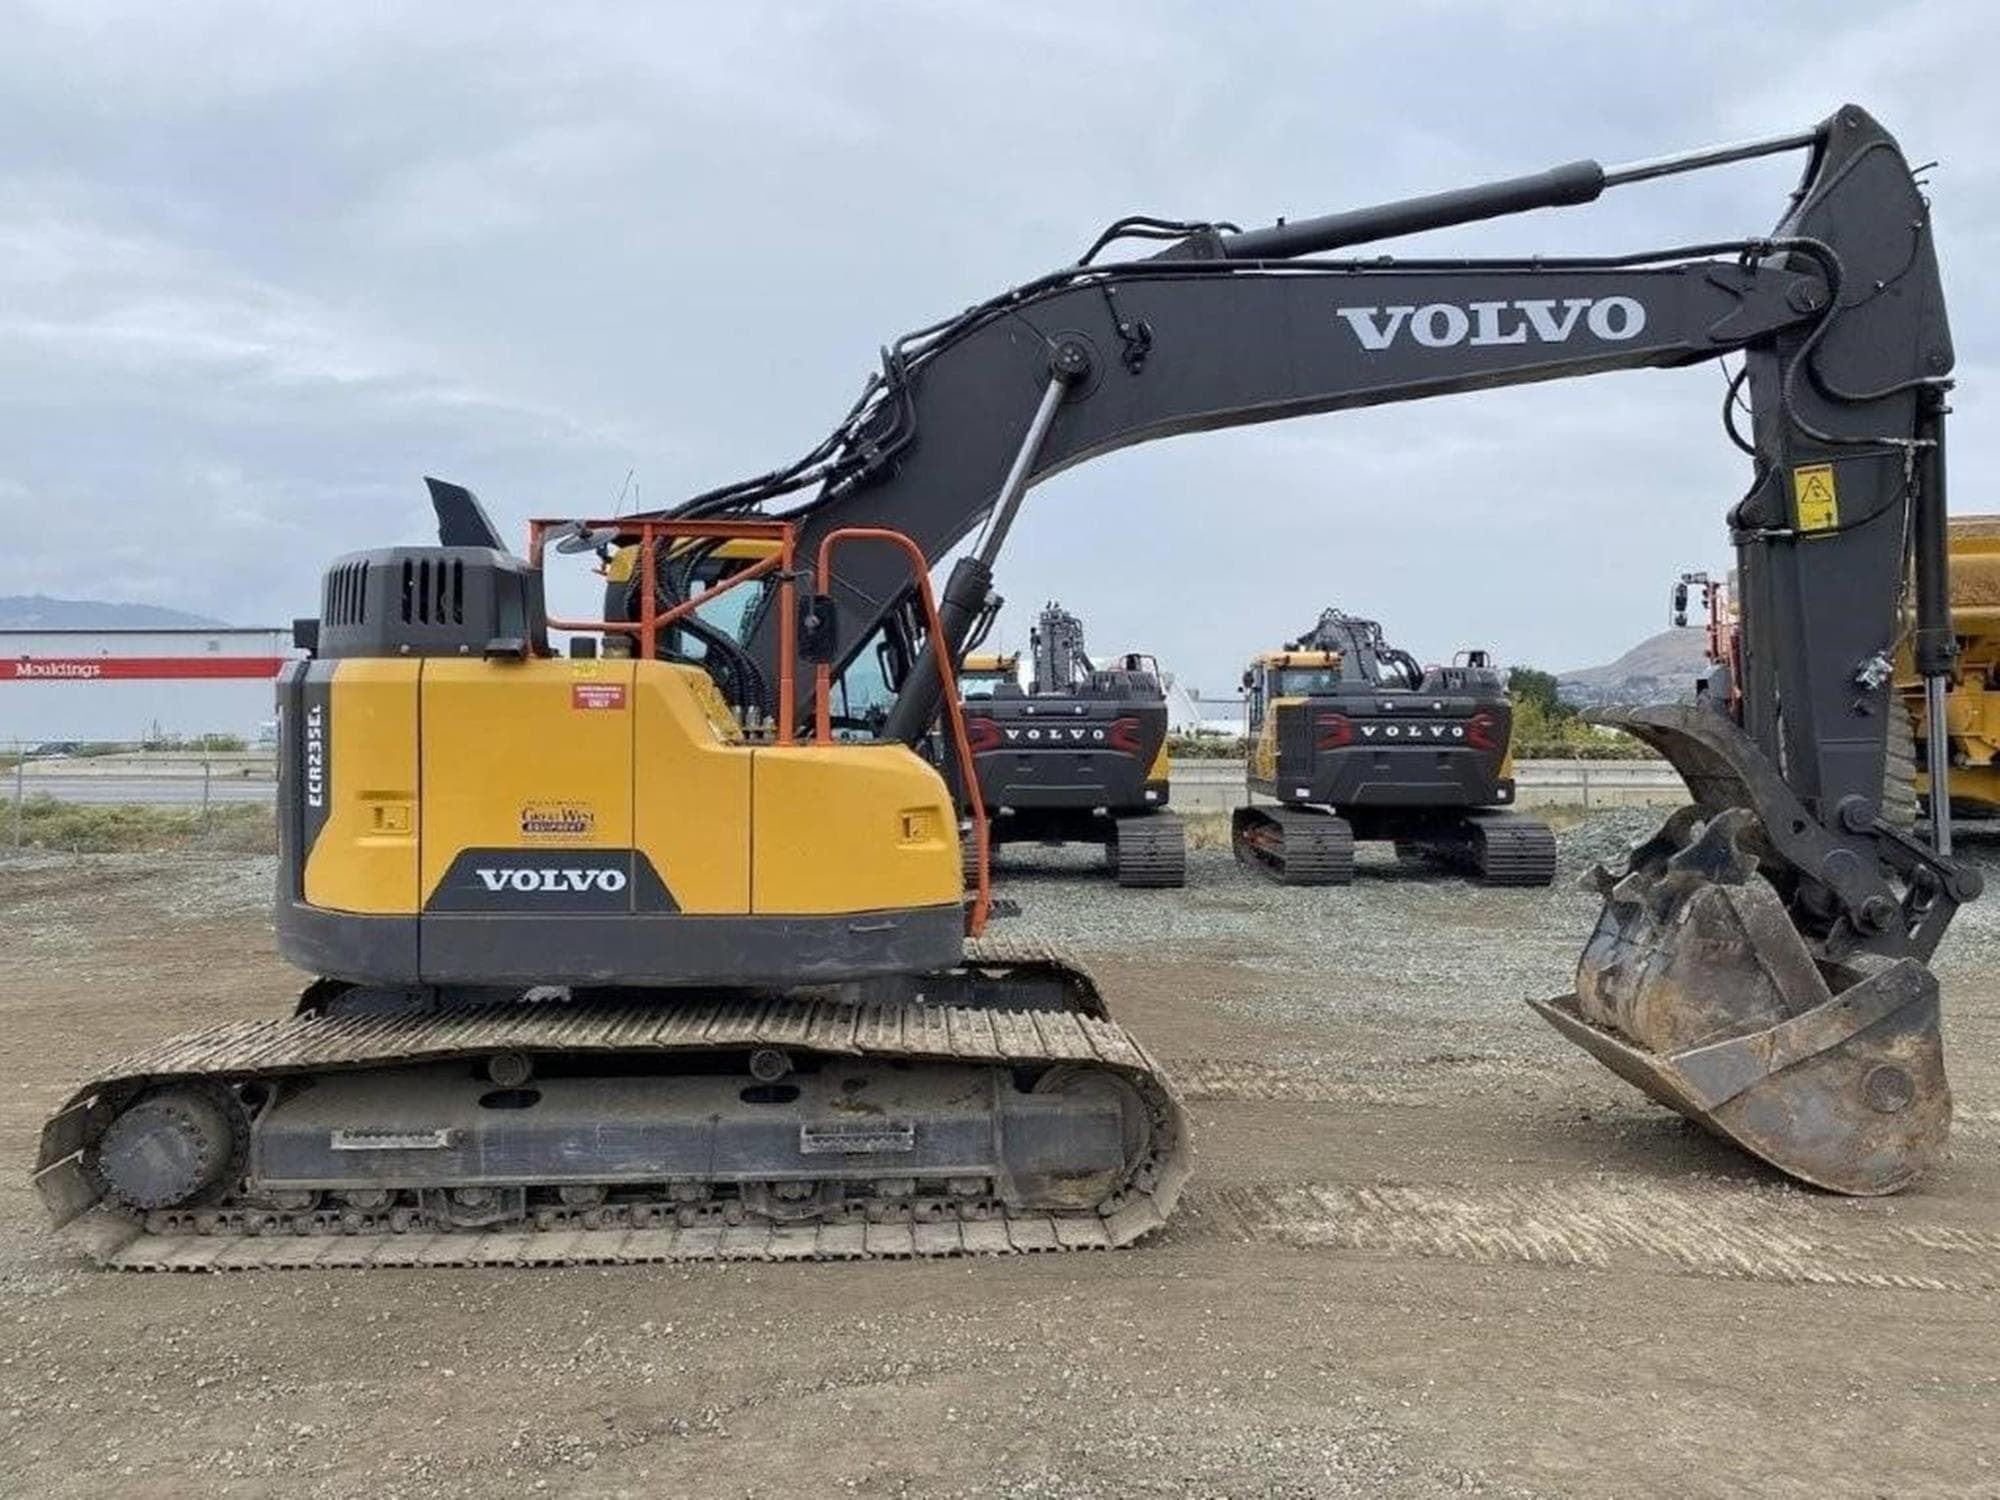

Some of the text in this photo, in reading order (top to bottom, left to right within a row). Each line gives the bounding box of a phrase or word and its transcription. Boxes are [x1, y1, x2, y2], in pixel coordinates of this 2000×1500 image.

[1337, 296, 1646, 350] VOLVO
[15, 662, 101, 678] Mouldings
[1005, 729, 1104, 740] VOLVO
[1361, 725, 1464, 738] VOLVO
[476, 869, 626, 892] VOLVO
